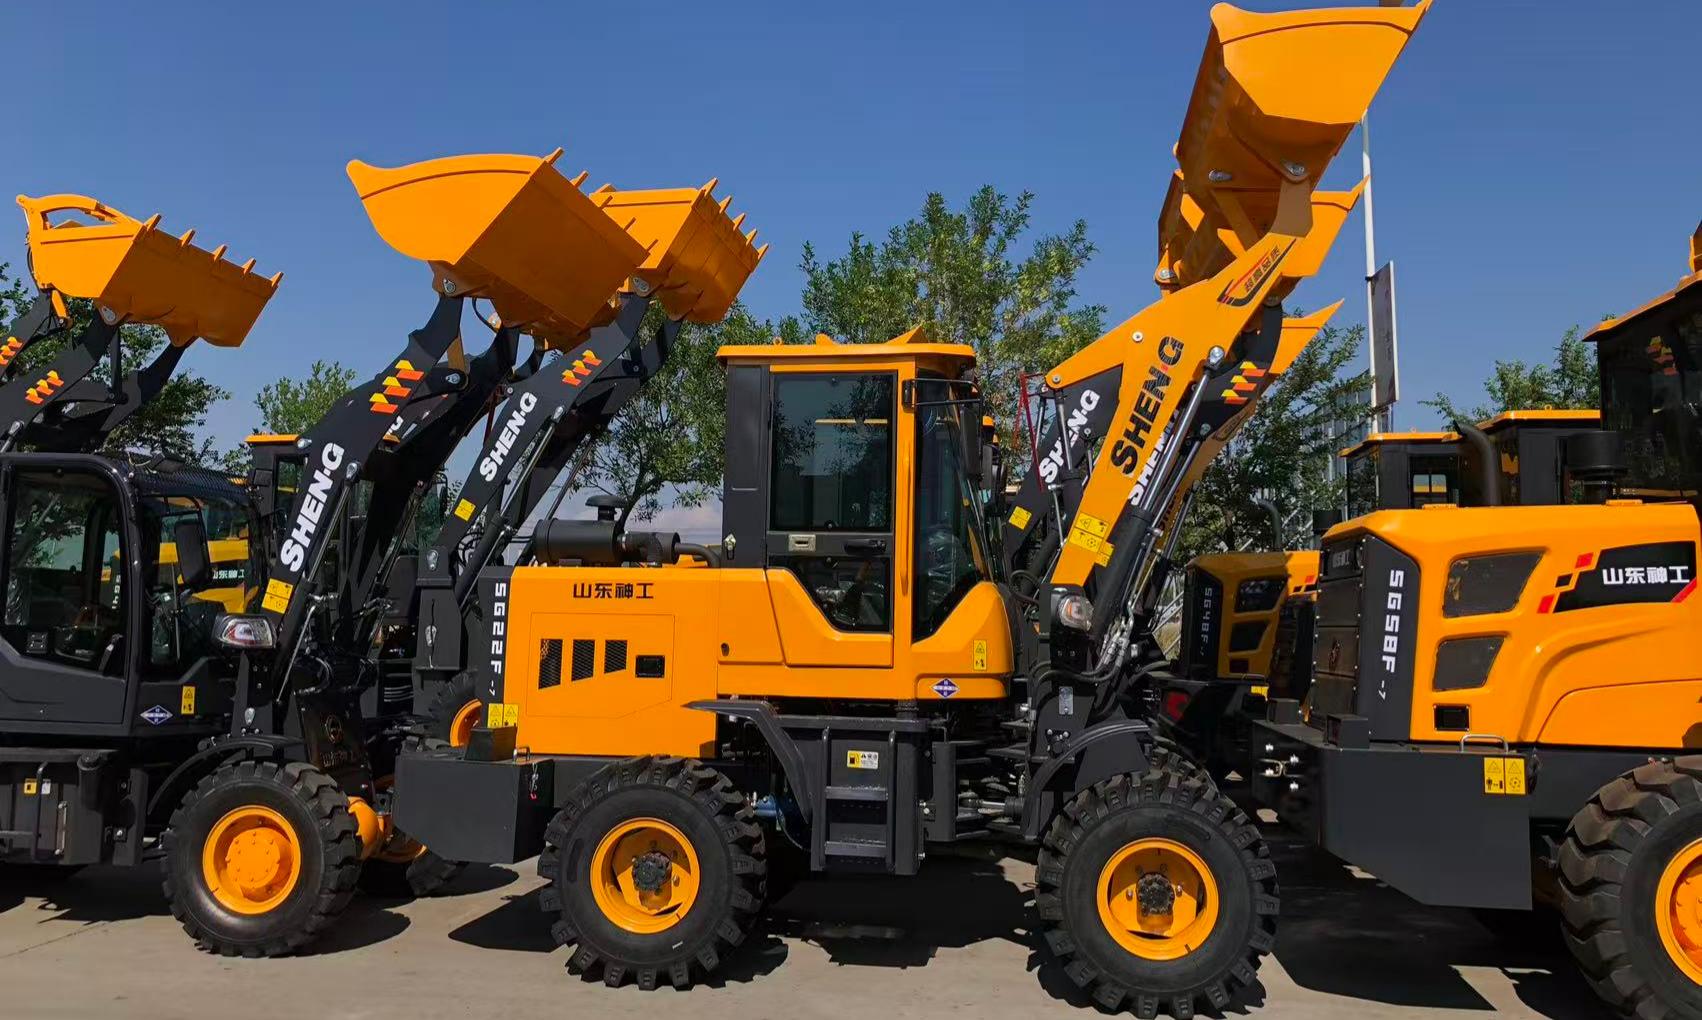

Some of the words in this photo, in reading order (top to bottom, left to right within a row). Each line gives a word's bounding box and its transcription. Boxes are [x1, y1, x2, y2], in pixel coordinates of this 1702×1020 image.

[1602, 565, 1690, 585] 山东神工
[573, 582, 654, 599] 山东神工
